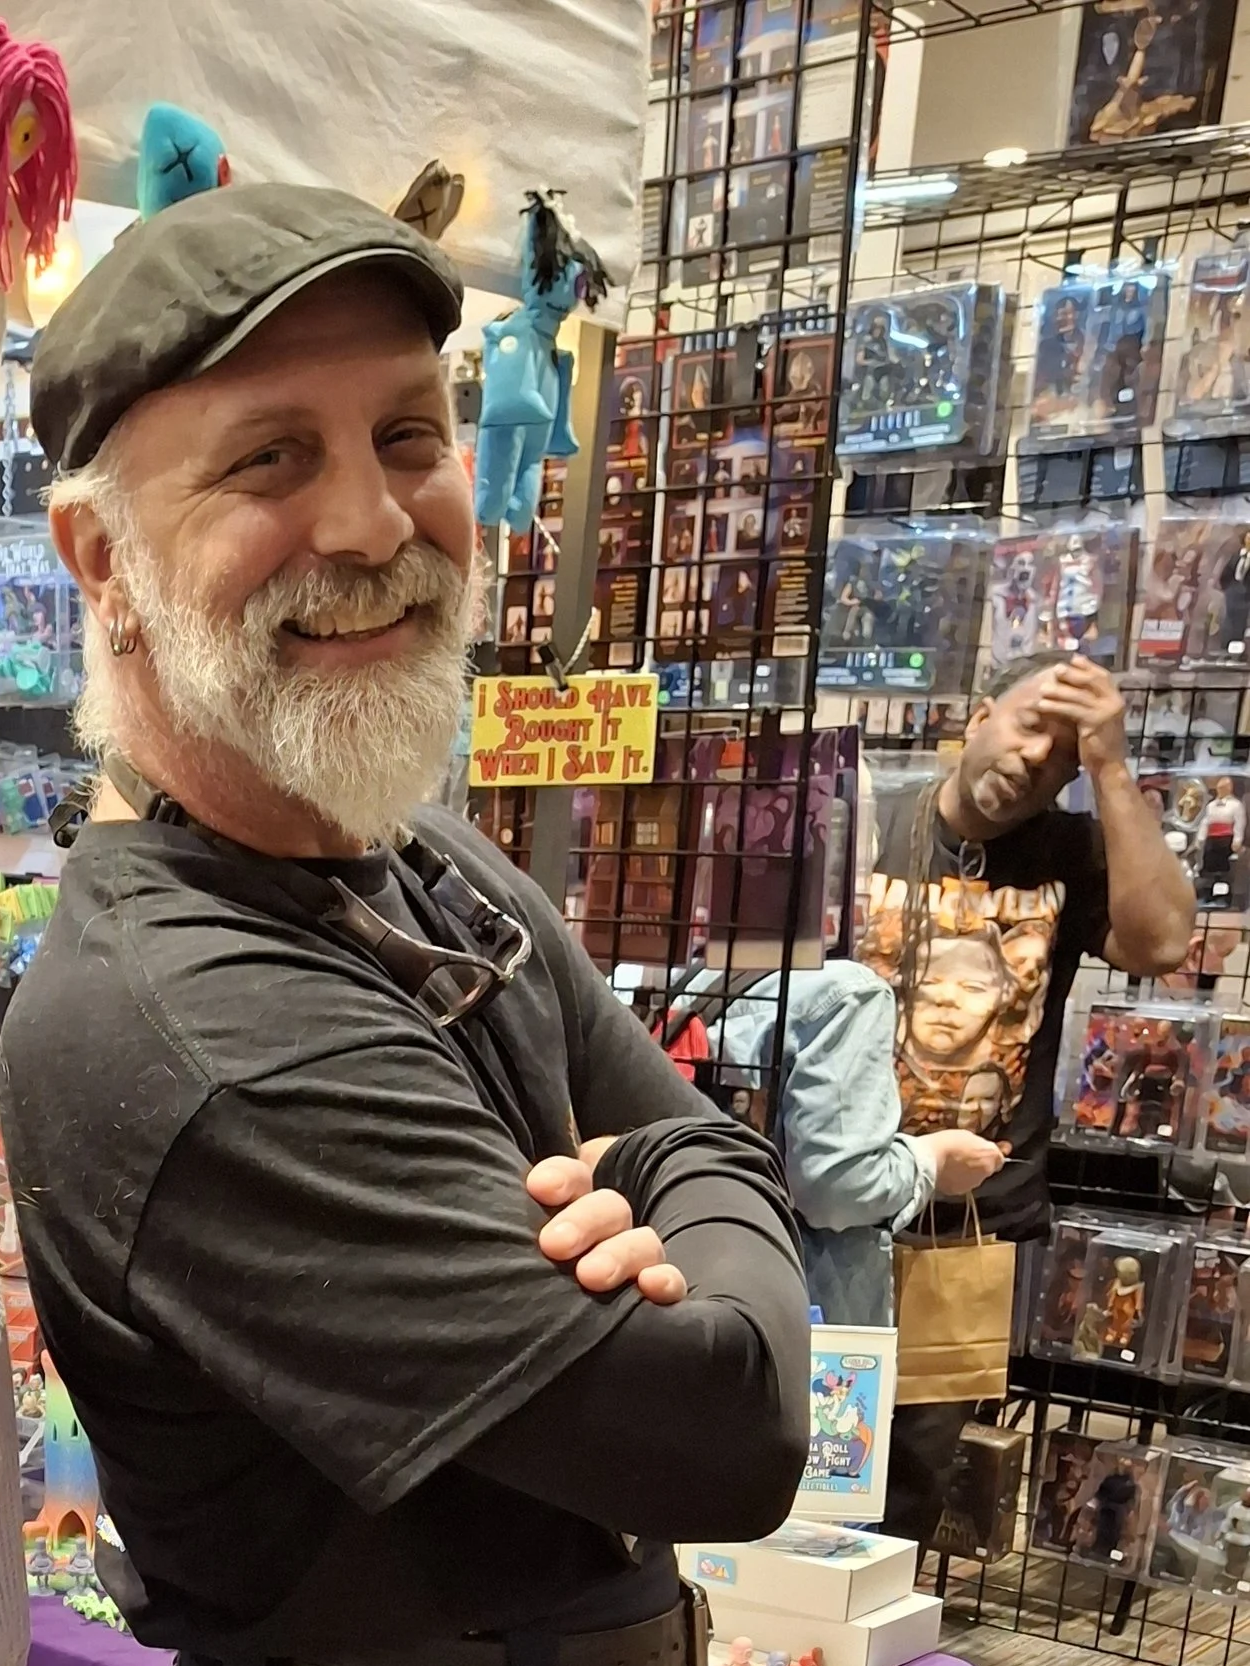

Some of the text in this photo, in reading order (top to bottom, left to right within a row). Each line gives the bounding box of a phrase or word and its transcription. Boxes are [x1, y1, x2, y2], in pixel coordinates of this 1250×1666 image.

[478, 684, 487, 717] I
[586, 680, 652, 713] HAVE
[504, 709, 622, 750] BOUGHT IT
[473, 744, 649, 781] WHEN I SAW IT.
[822, 1441, 848, 1455] DOLL
[803, 1465, 831, 1479] GAME
